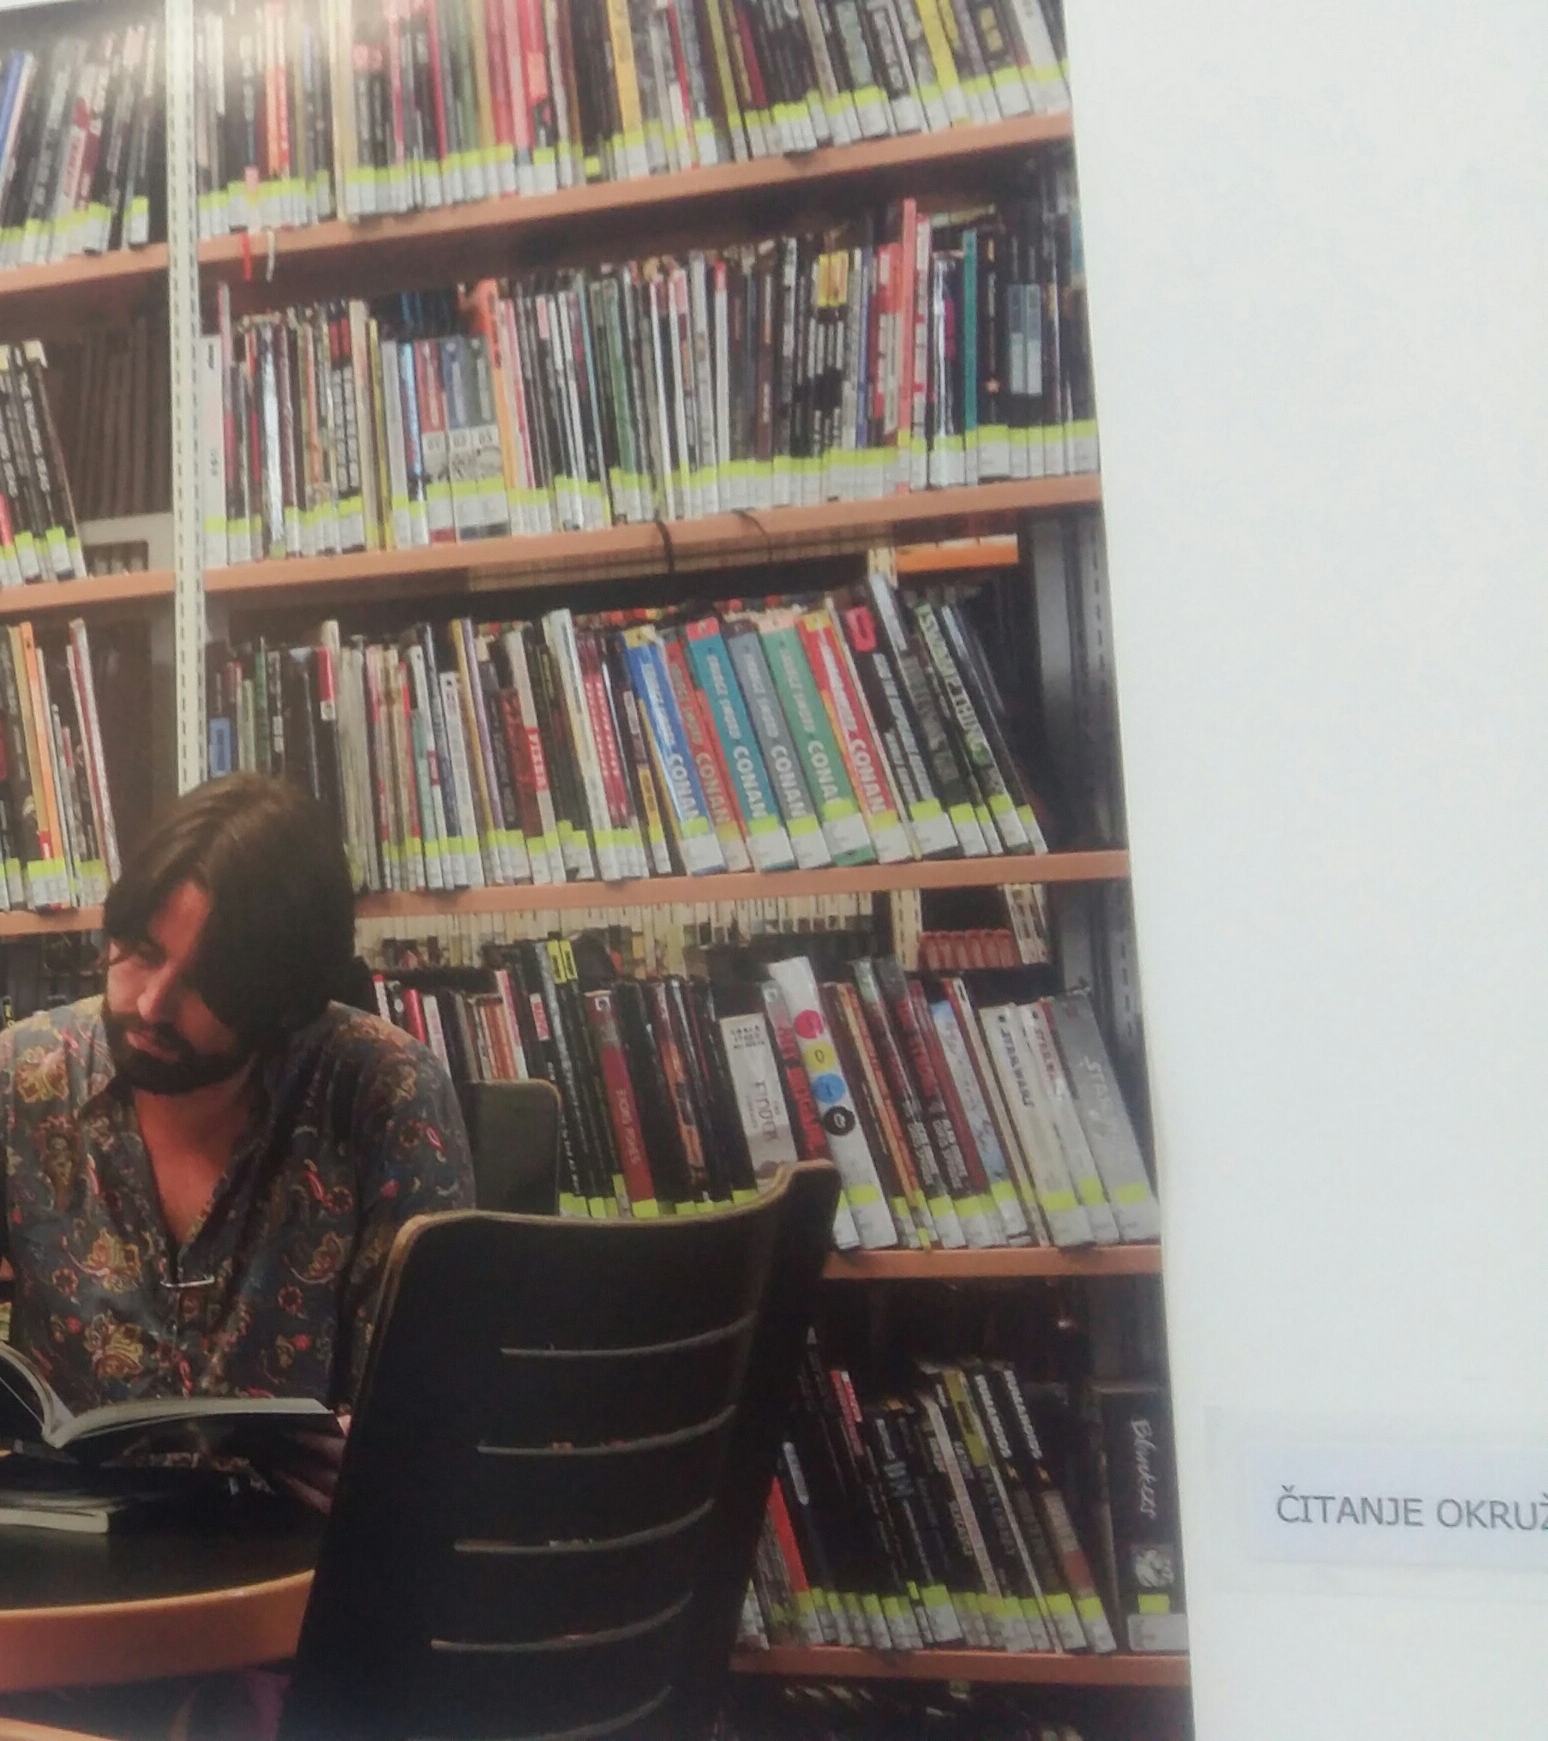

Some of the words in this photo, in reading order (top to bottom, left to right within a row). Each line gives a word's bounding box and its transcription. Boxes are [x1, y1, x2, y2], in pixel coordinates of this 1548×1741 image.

[694, 750, 730, 826] CONAN
[731, 744, 765, 820] CONAN
[769, 743, 808, 819] CONAN
[848, 737, 887, 814] CONAN
[976, 1374, 1014, 1459] HUMANOIDS
[1005, 1369, 1043, 1460] HUMANOIDS
[1276, 1485, 1425, 1527] ČITANJE
